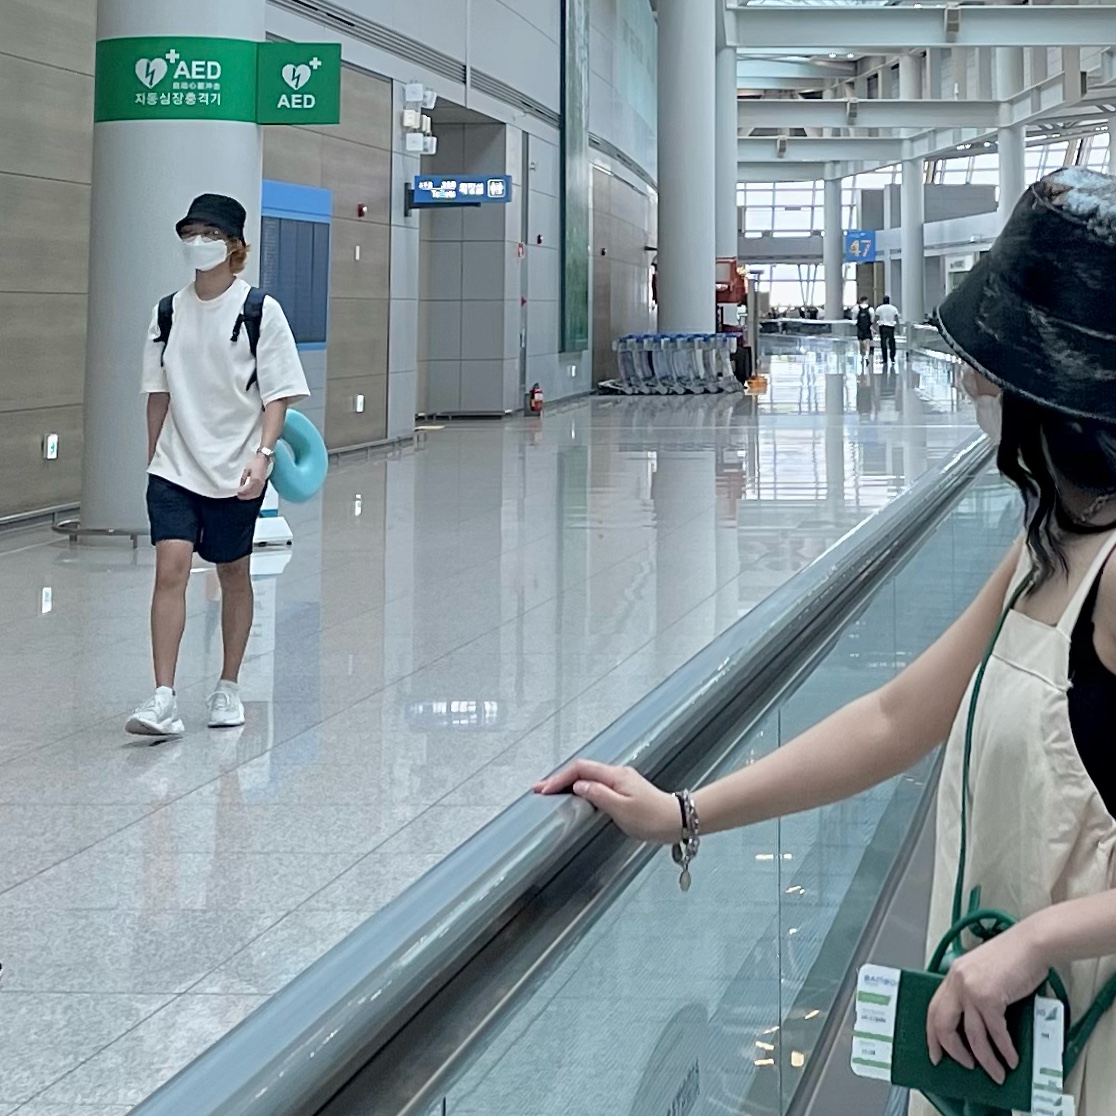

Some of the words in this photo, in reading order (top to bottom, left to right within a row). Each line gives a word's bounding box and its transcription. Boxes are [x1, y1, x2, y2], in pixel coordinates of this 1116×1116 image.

[173, 60, 222, 80] AED
[134, 92, 221, 106] 자동심장충격기
[276, 94, 316, 109] AED
[849, 239, 872, 257] 47
